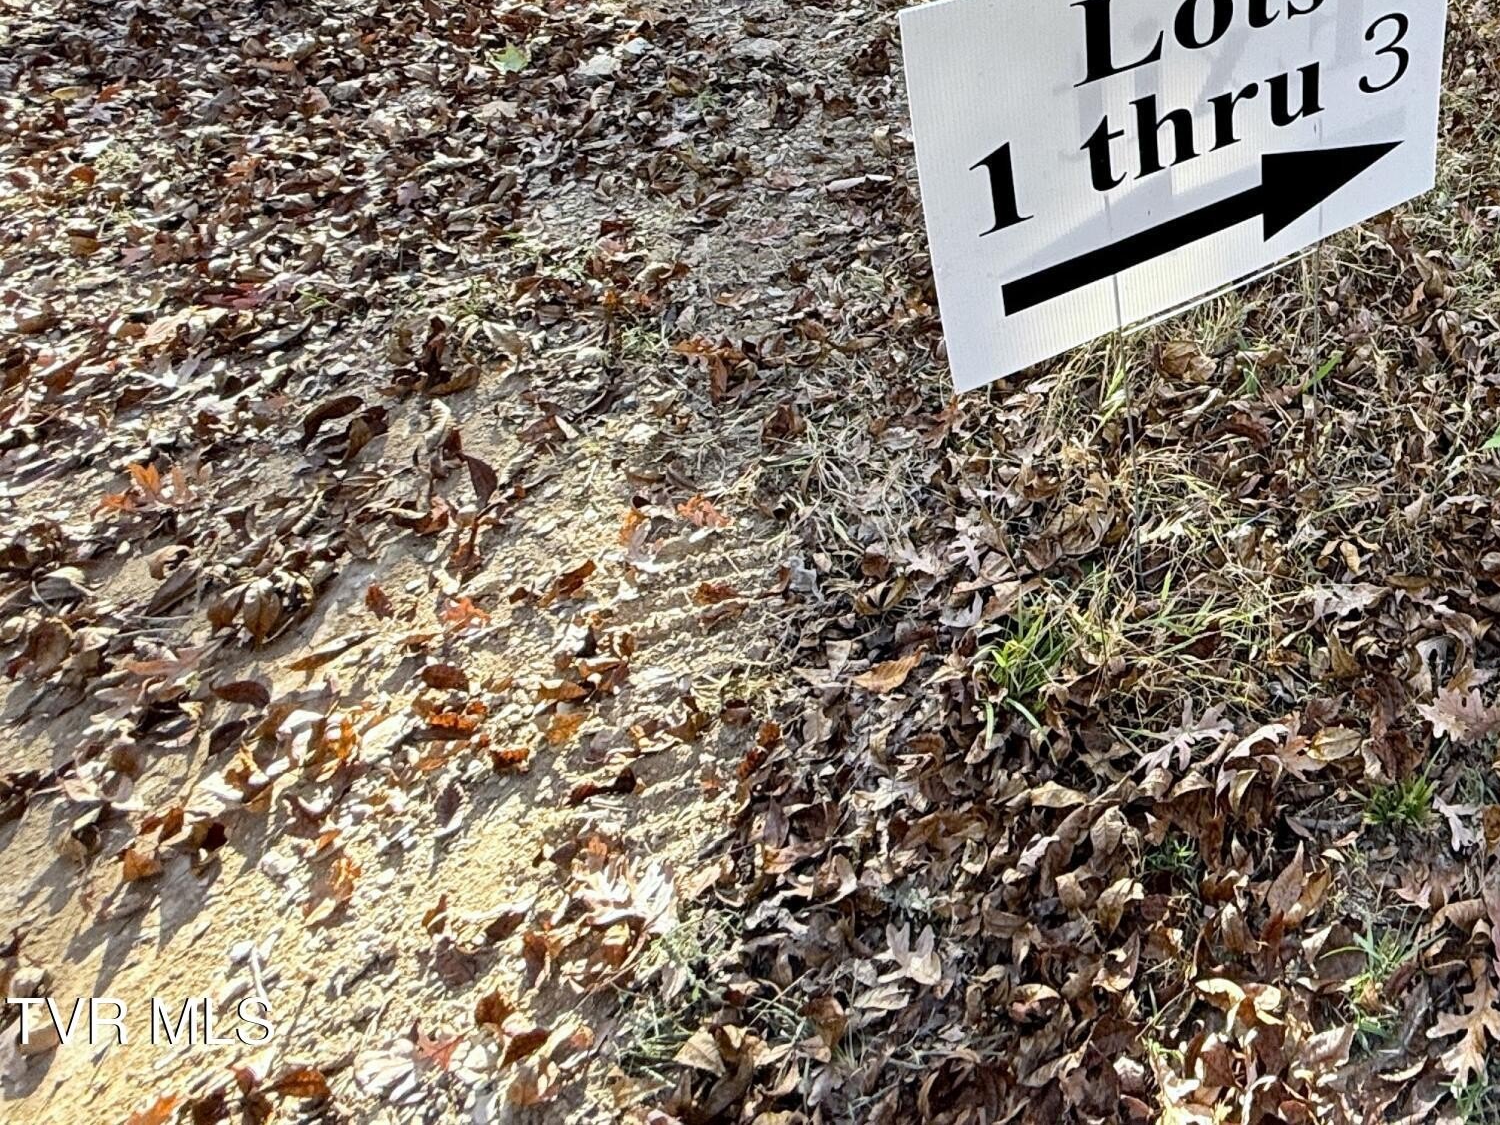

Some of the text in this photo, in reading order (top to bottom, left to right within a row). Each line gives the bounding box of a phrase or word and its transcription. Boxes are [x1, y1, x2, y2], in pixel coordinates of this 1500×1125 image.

[968, 141, 1035, 238] 1
[1079, 60, 1326, 193] thru
[1357, 11, 1410, 95] 3
